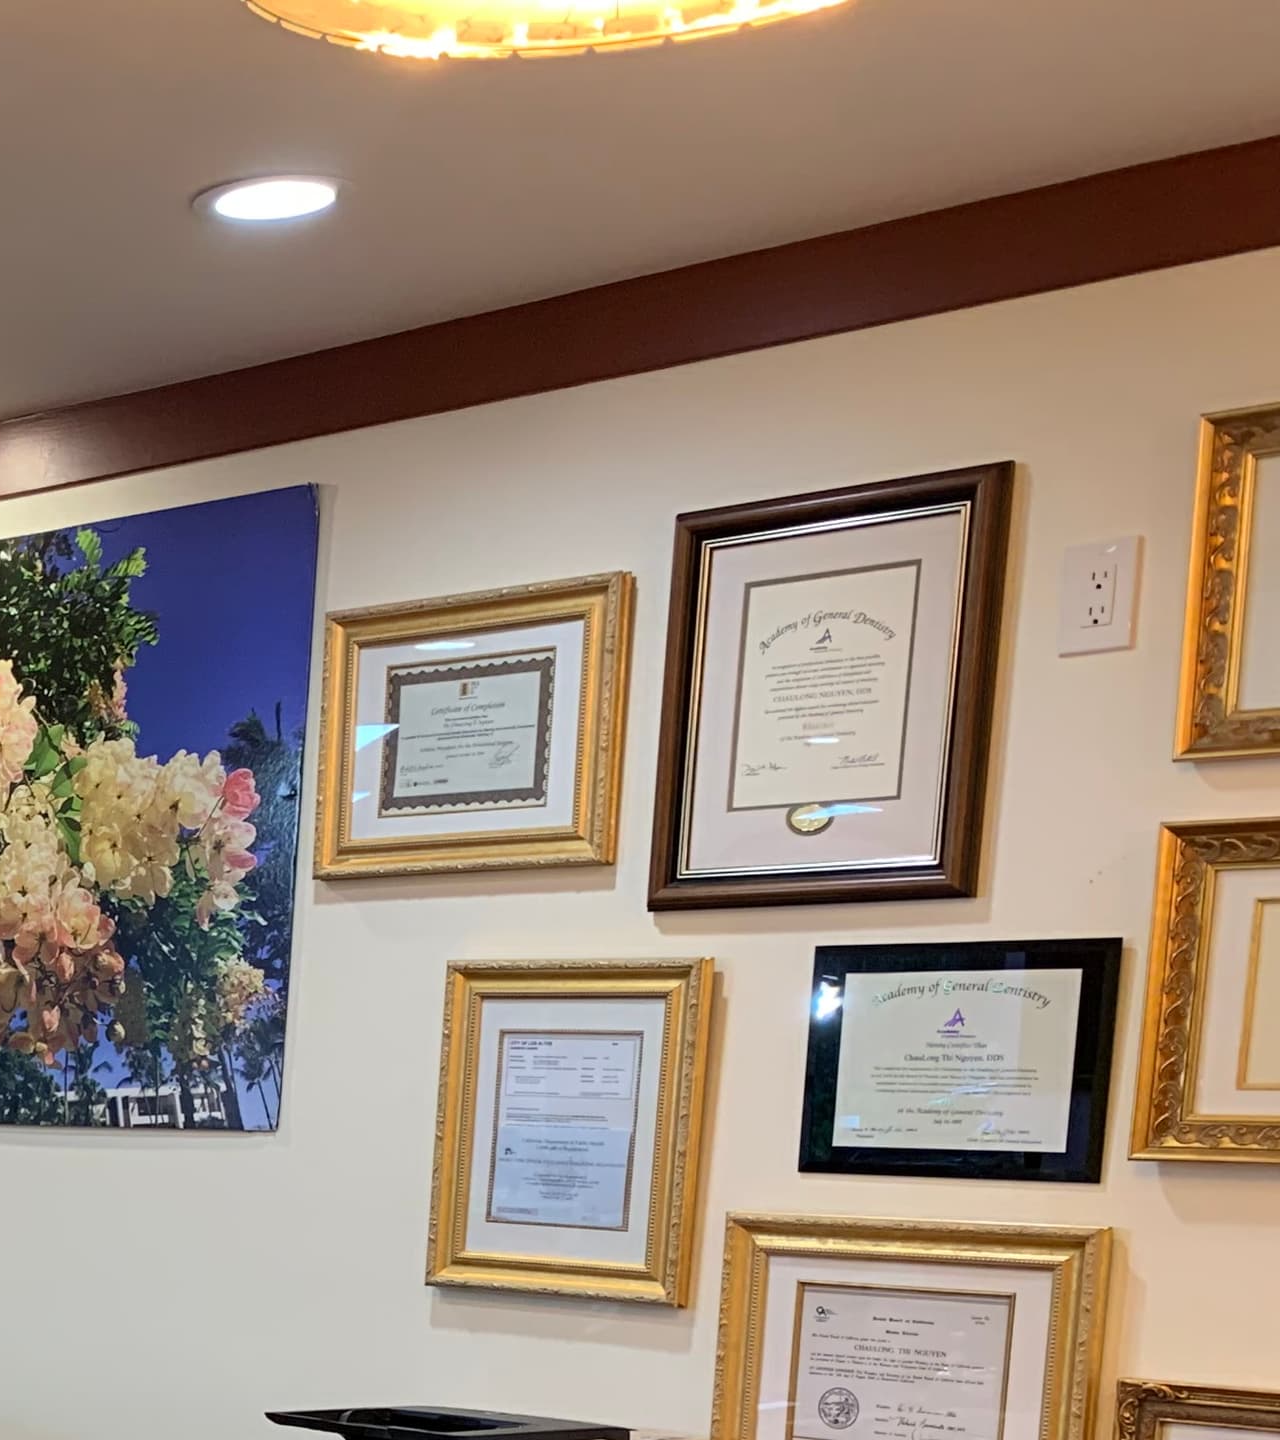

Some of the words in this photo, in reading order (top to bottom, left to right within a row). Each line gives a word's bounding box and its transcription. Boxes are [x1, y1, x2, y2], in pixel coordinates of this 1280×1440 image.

[759, 620, 798, 655] Academy
[801, 614, 811, 627] of
[813, 609, 853, 627] General
[853, 611, 896, 641] Dentistry
[872, 983, 925, 1007] Academy
[928, 978, 941, 998] of
[943, 977, 992, 996] General
[992, 981, 1051, 1009] Dentistry
